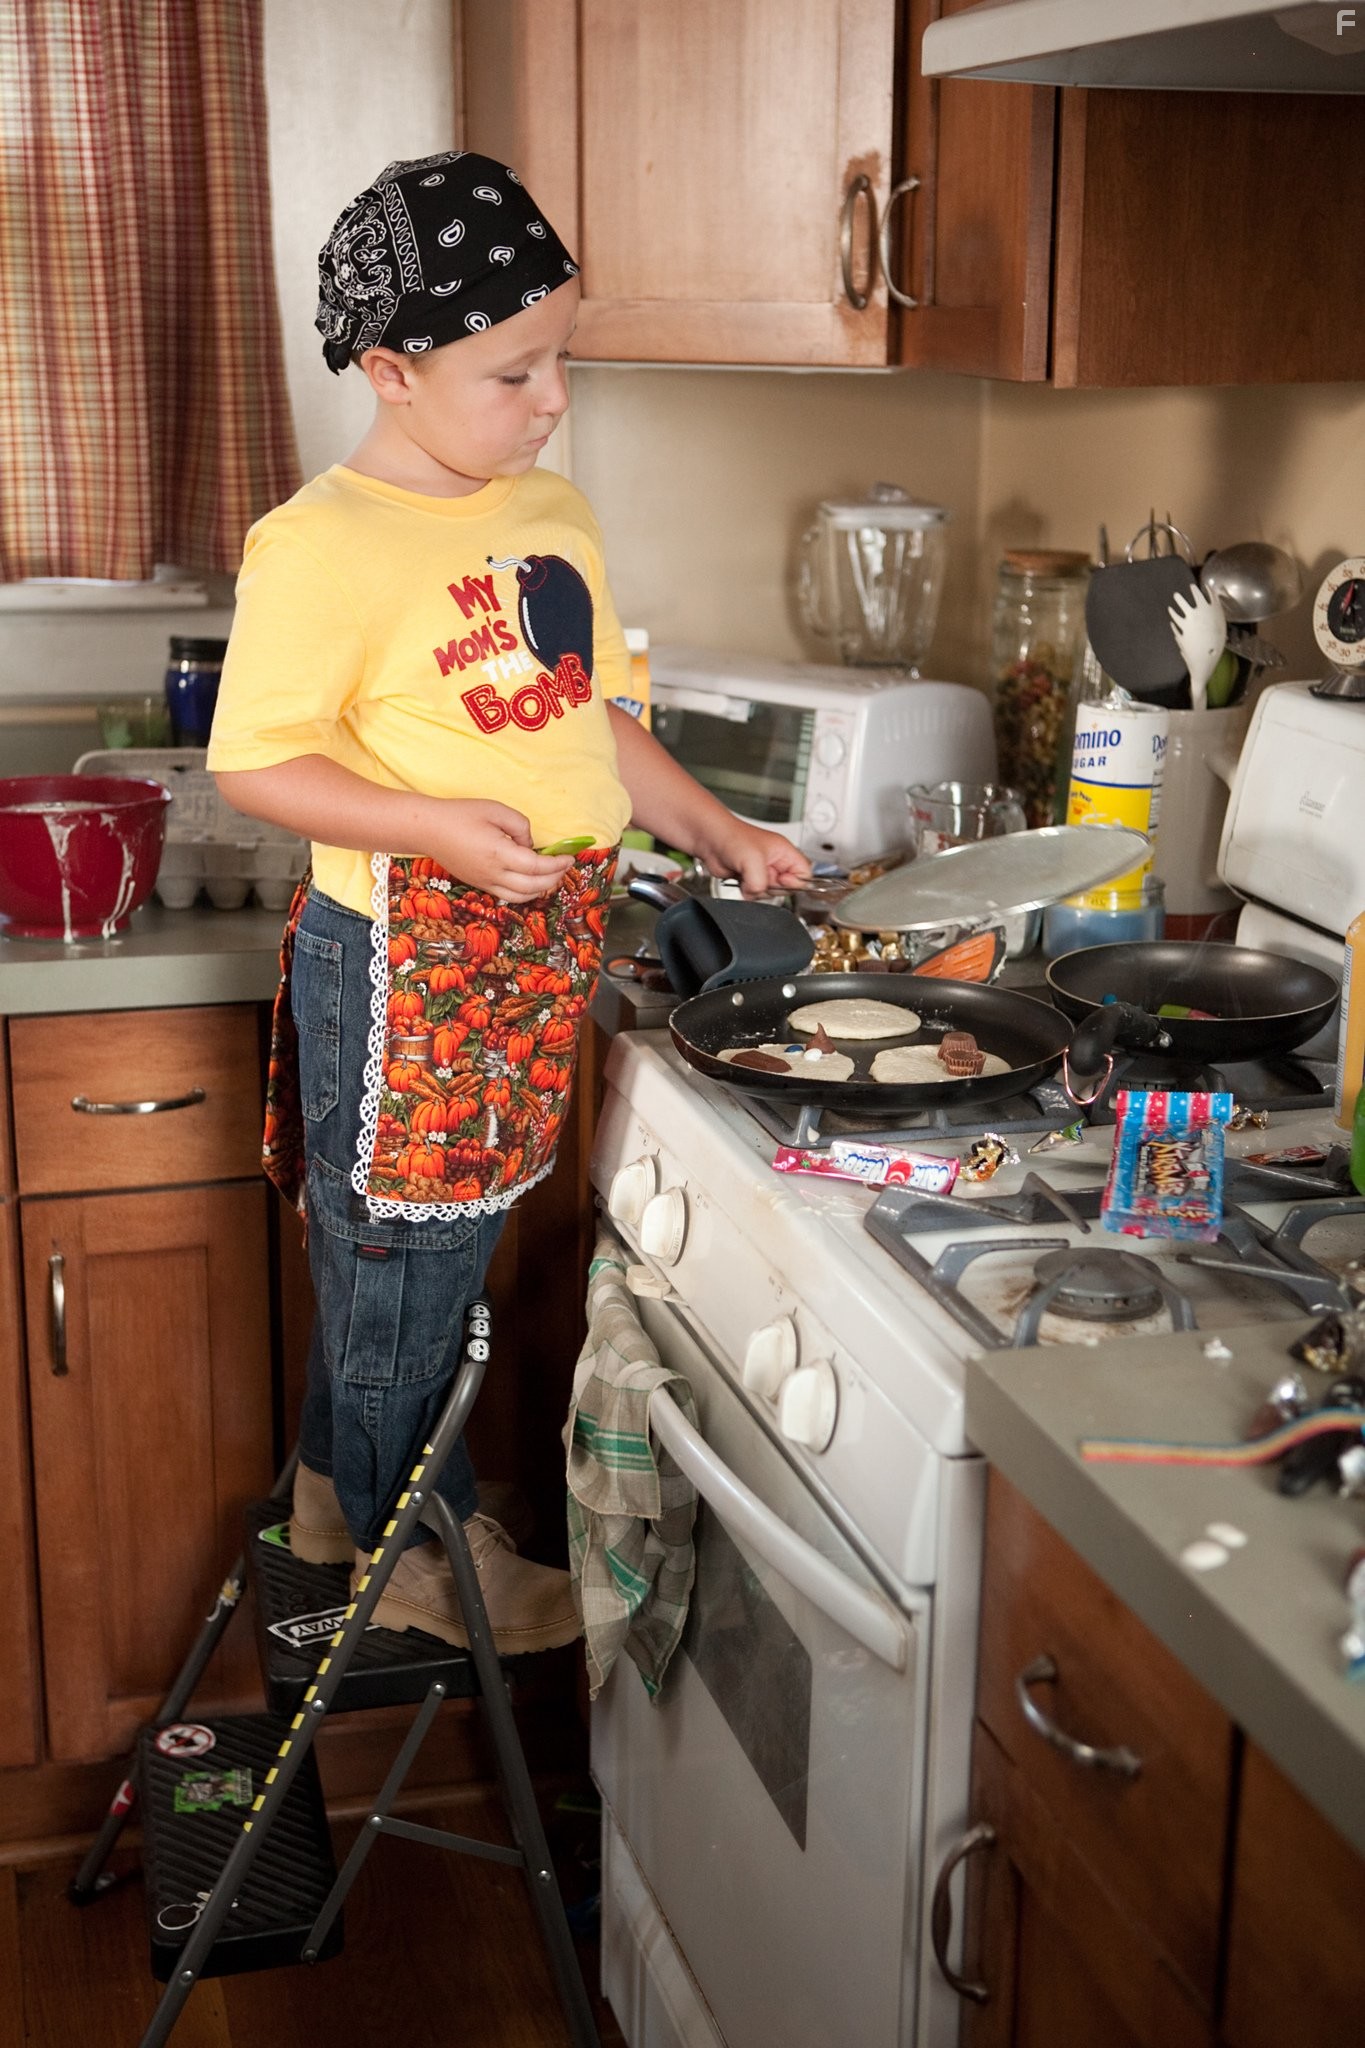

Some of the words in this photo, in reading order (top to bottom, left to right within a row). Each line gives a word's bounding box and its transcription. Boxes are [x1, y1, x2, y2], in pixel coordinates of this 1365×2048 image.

[447, 574, 502, 620] MY
[432, 616, 519, 677] MOM'S
[481, 650, 534, 683] THE
[460, 652, 592, 734] BOMB
[1073, 729, 1122, 750] omino
[1073, 756, 1107, 769] UGAR
[296, 1618, 345, 1637] WAY
